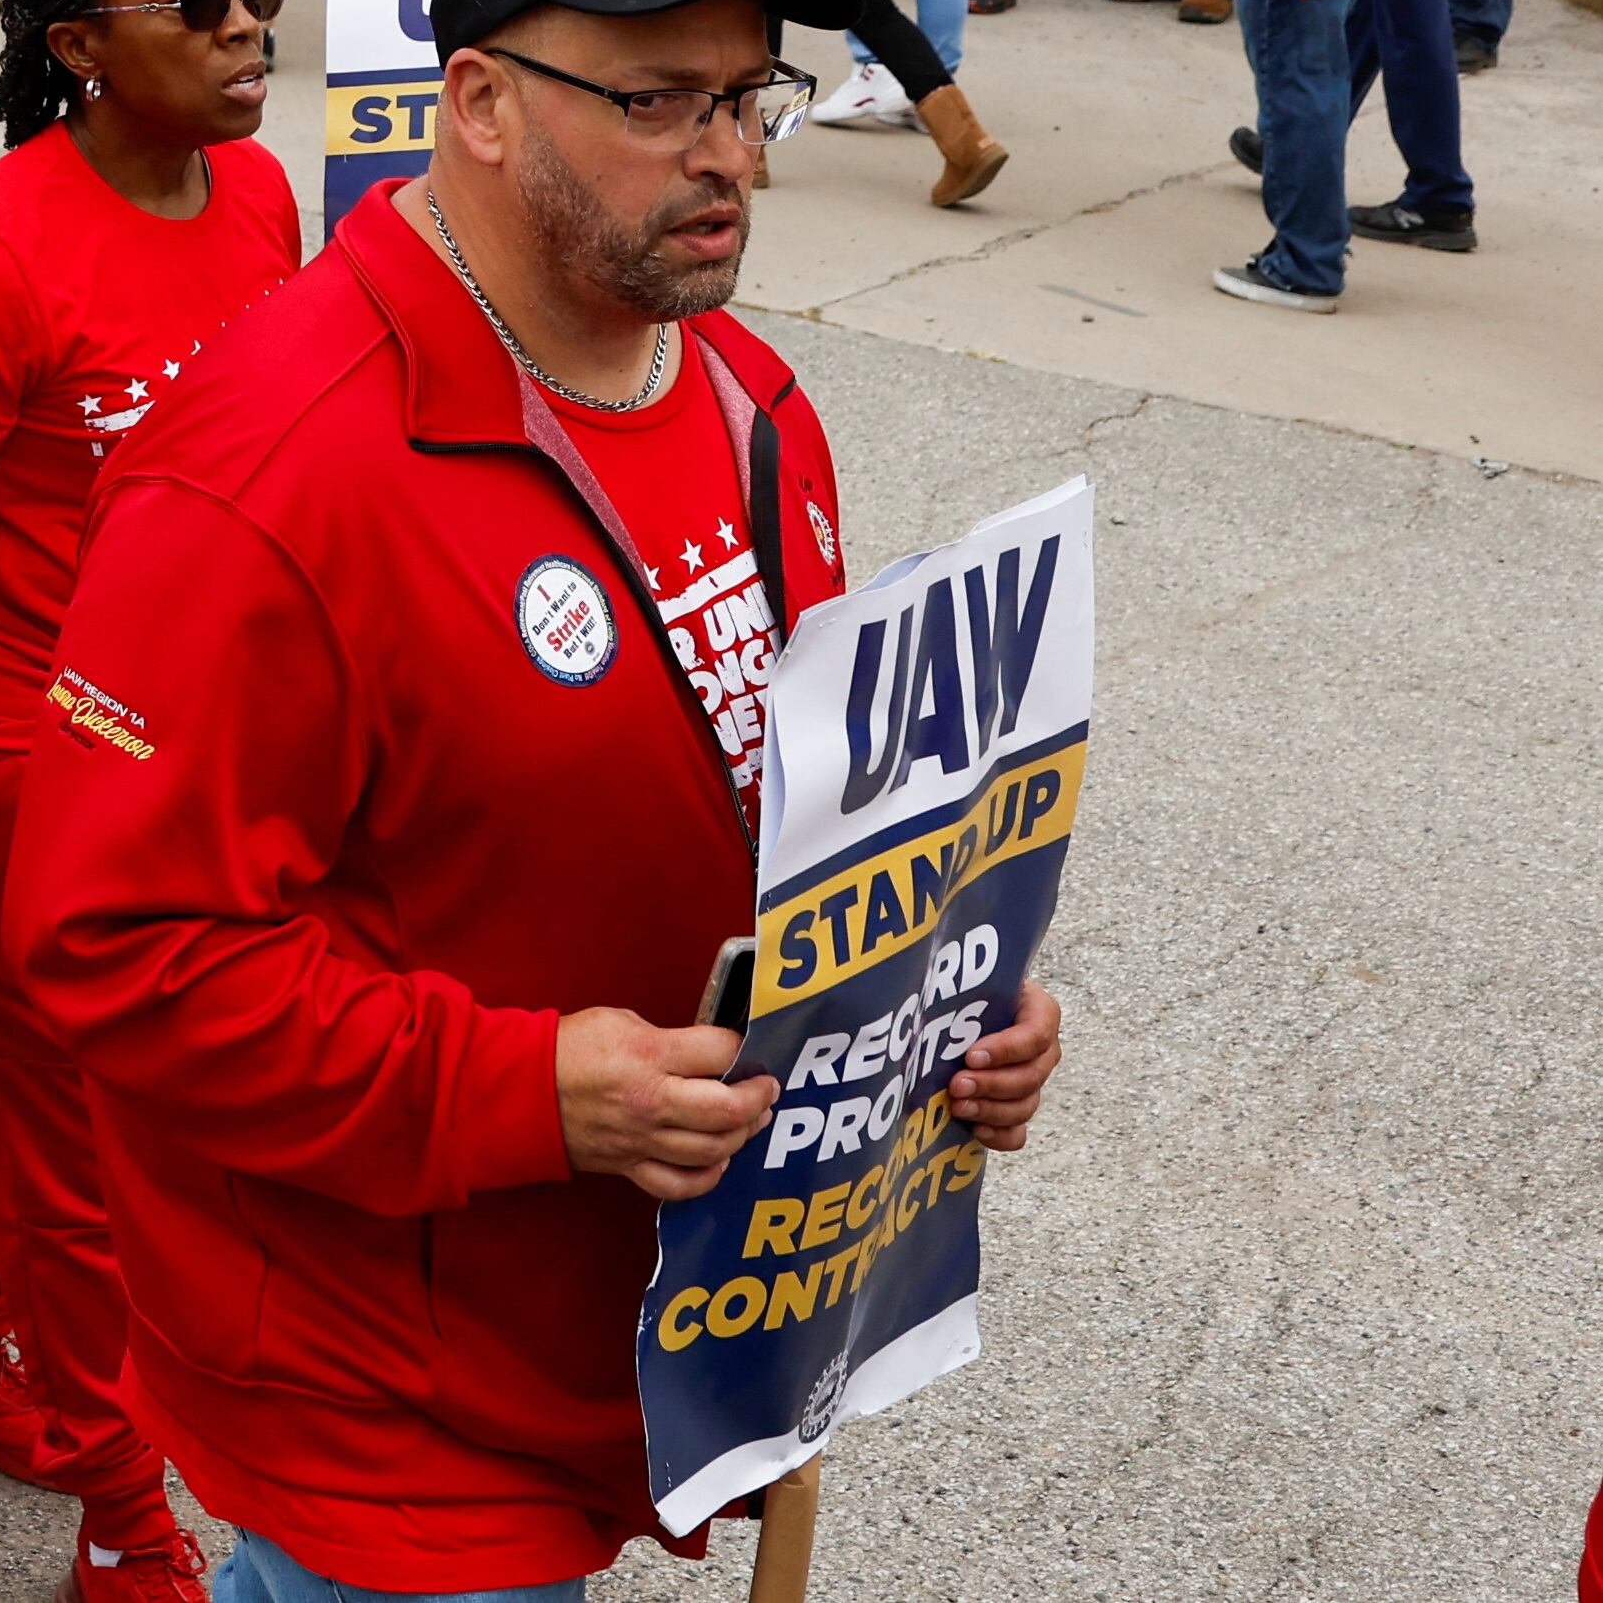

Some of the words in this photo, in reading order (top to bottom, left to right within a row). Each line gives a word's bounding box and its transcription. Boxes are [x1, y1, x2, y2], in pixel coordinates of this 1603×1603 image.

[532, 610, 555, 636] Don't
[550, 590, 569, 613] Want
[567, 582, 577, 592] to
[536, 584, 551, 602] I
[546, 599, 590, 652] Strike
[563, 641, 579, 659] But
[840, 534, 1061, 815] UAW
[64, 665, 84, 687] UAW
[83, 681, 129, 718] REGION
[130, 711, 146, 730] 1A
[71, 696, 156, 761] Dickerson
[777, 835, 980, 991] STAND
[982, 766, 1062, 864] UP
[657, 1138, 985, 1354] CONTRACTS
